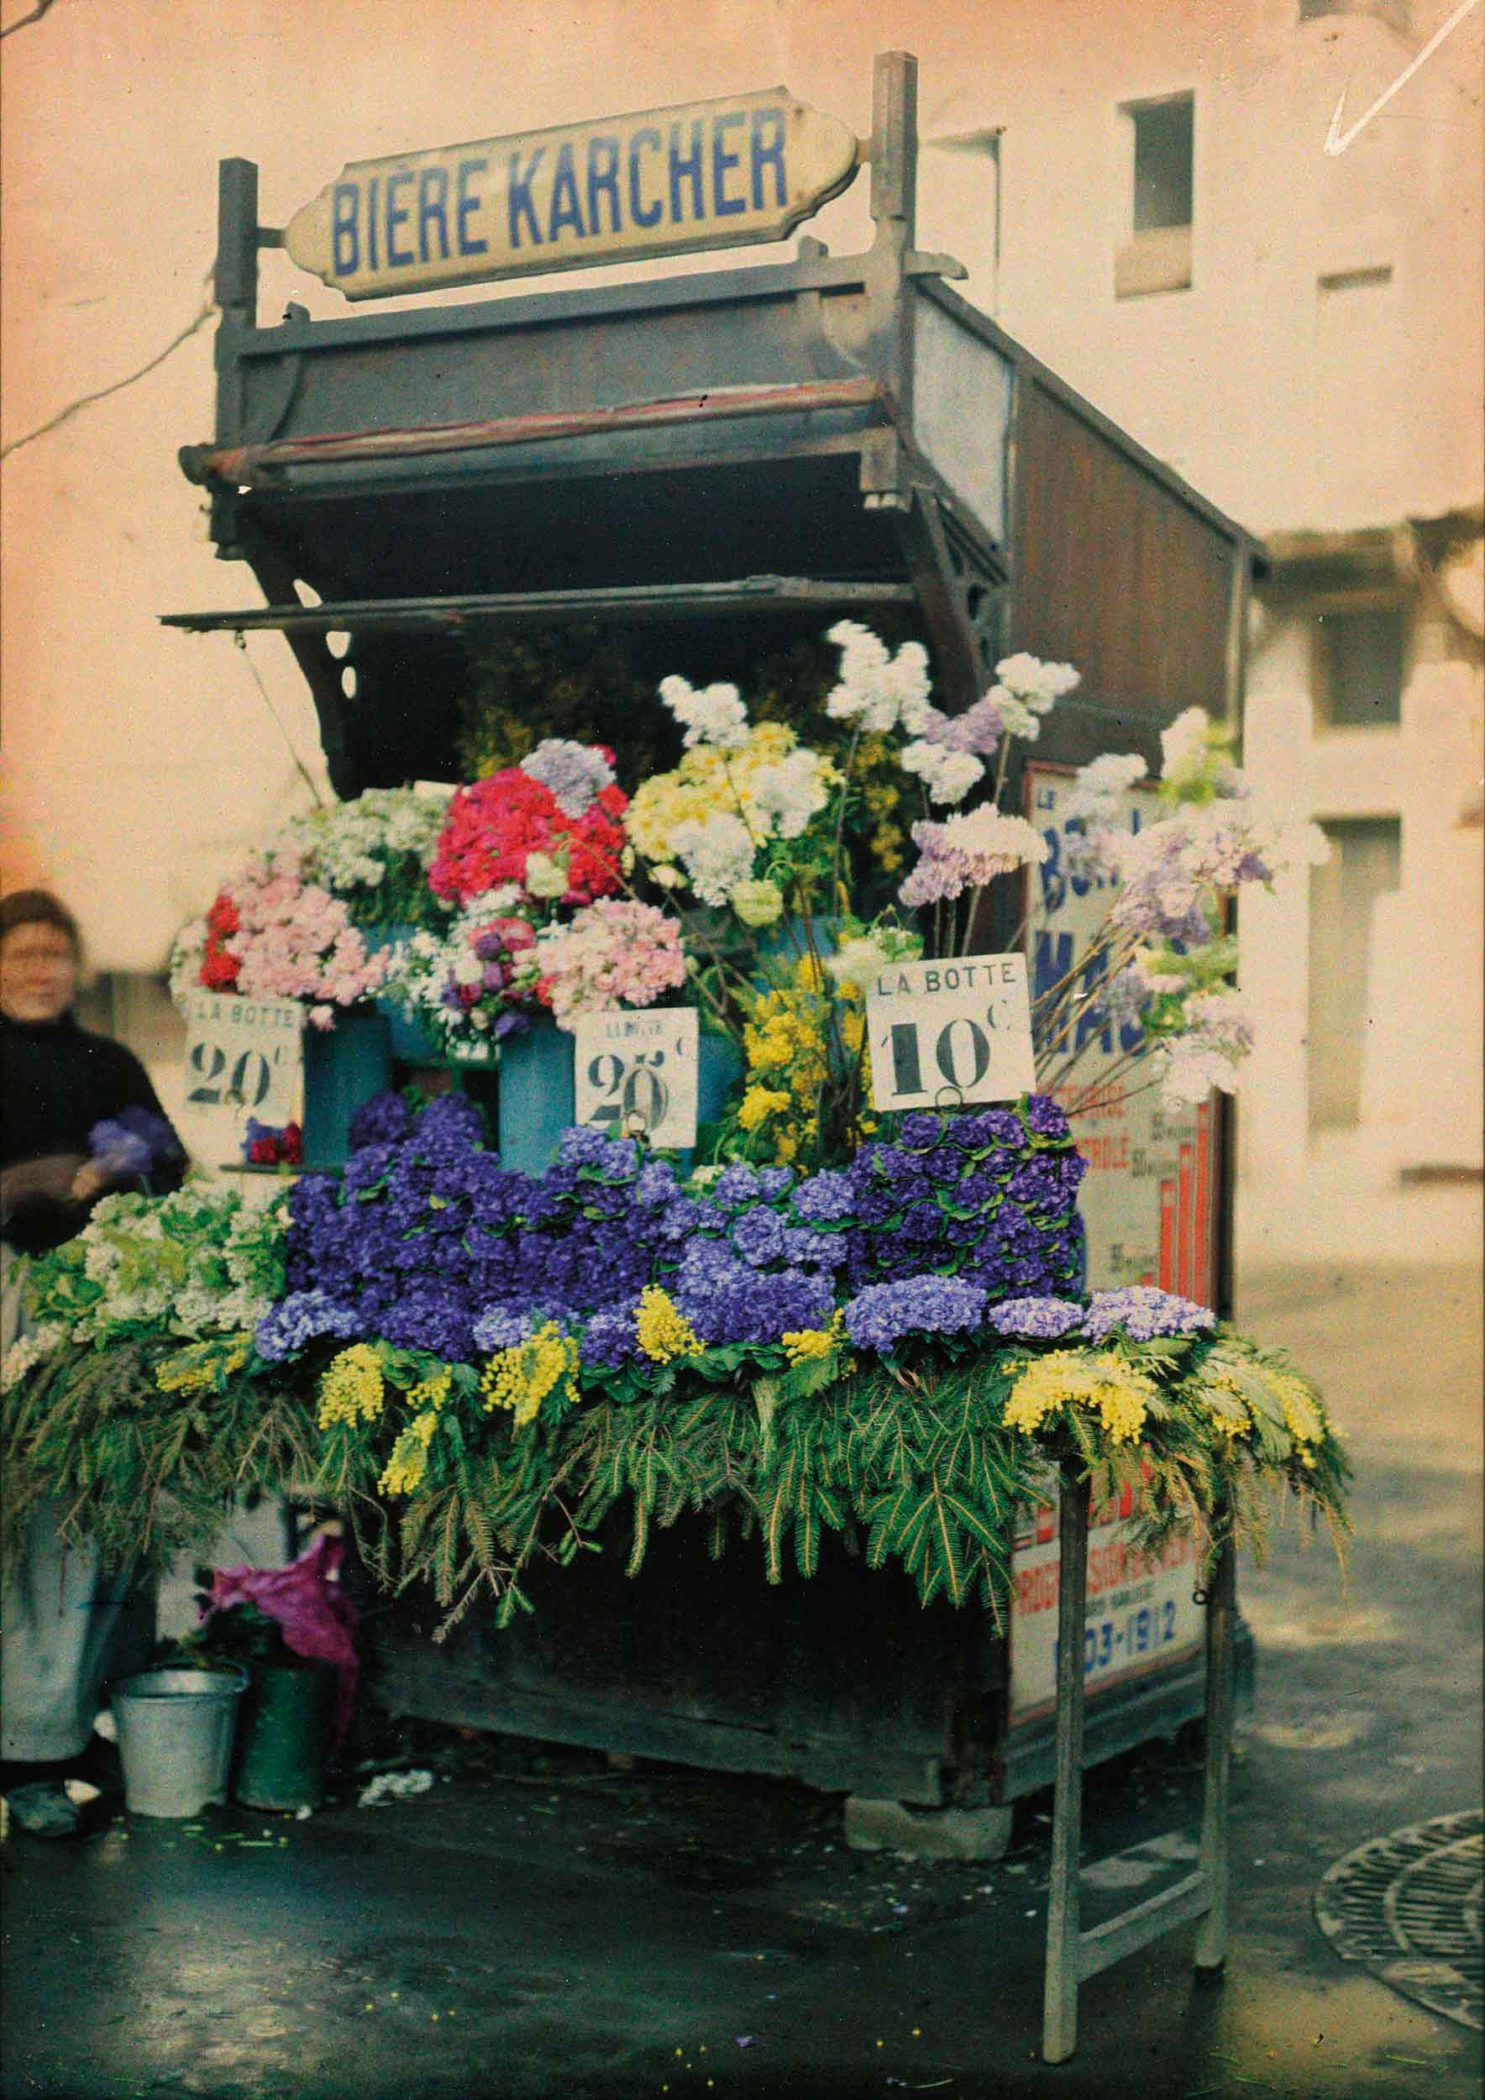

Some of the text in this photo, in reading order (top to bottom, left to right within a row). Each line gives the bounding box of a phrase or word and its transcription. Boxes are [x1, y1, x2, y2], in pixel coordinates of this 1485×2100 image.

[507, 107, 788, 249] KARCHER
[877, 962, 1016, 997] LA BOTTE
[232, 1003, 293, 1029] BOTTE
